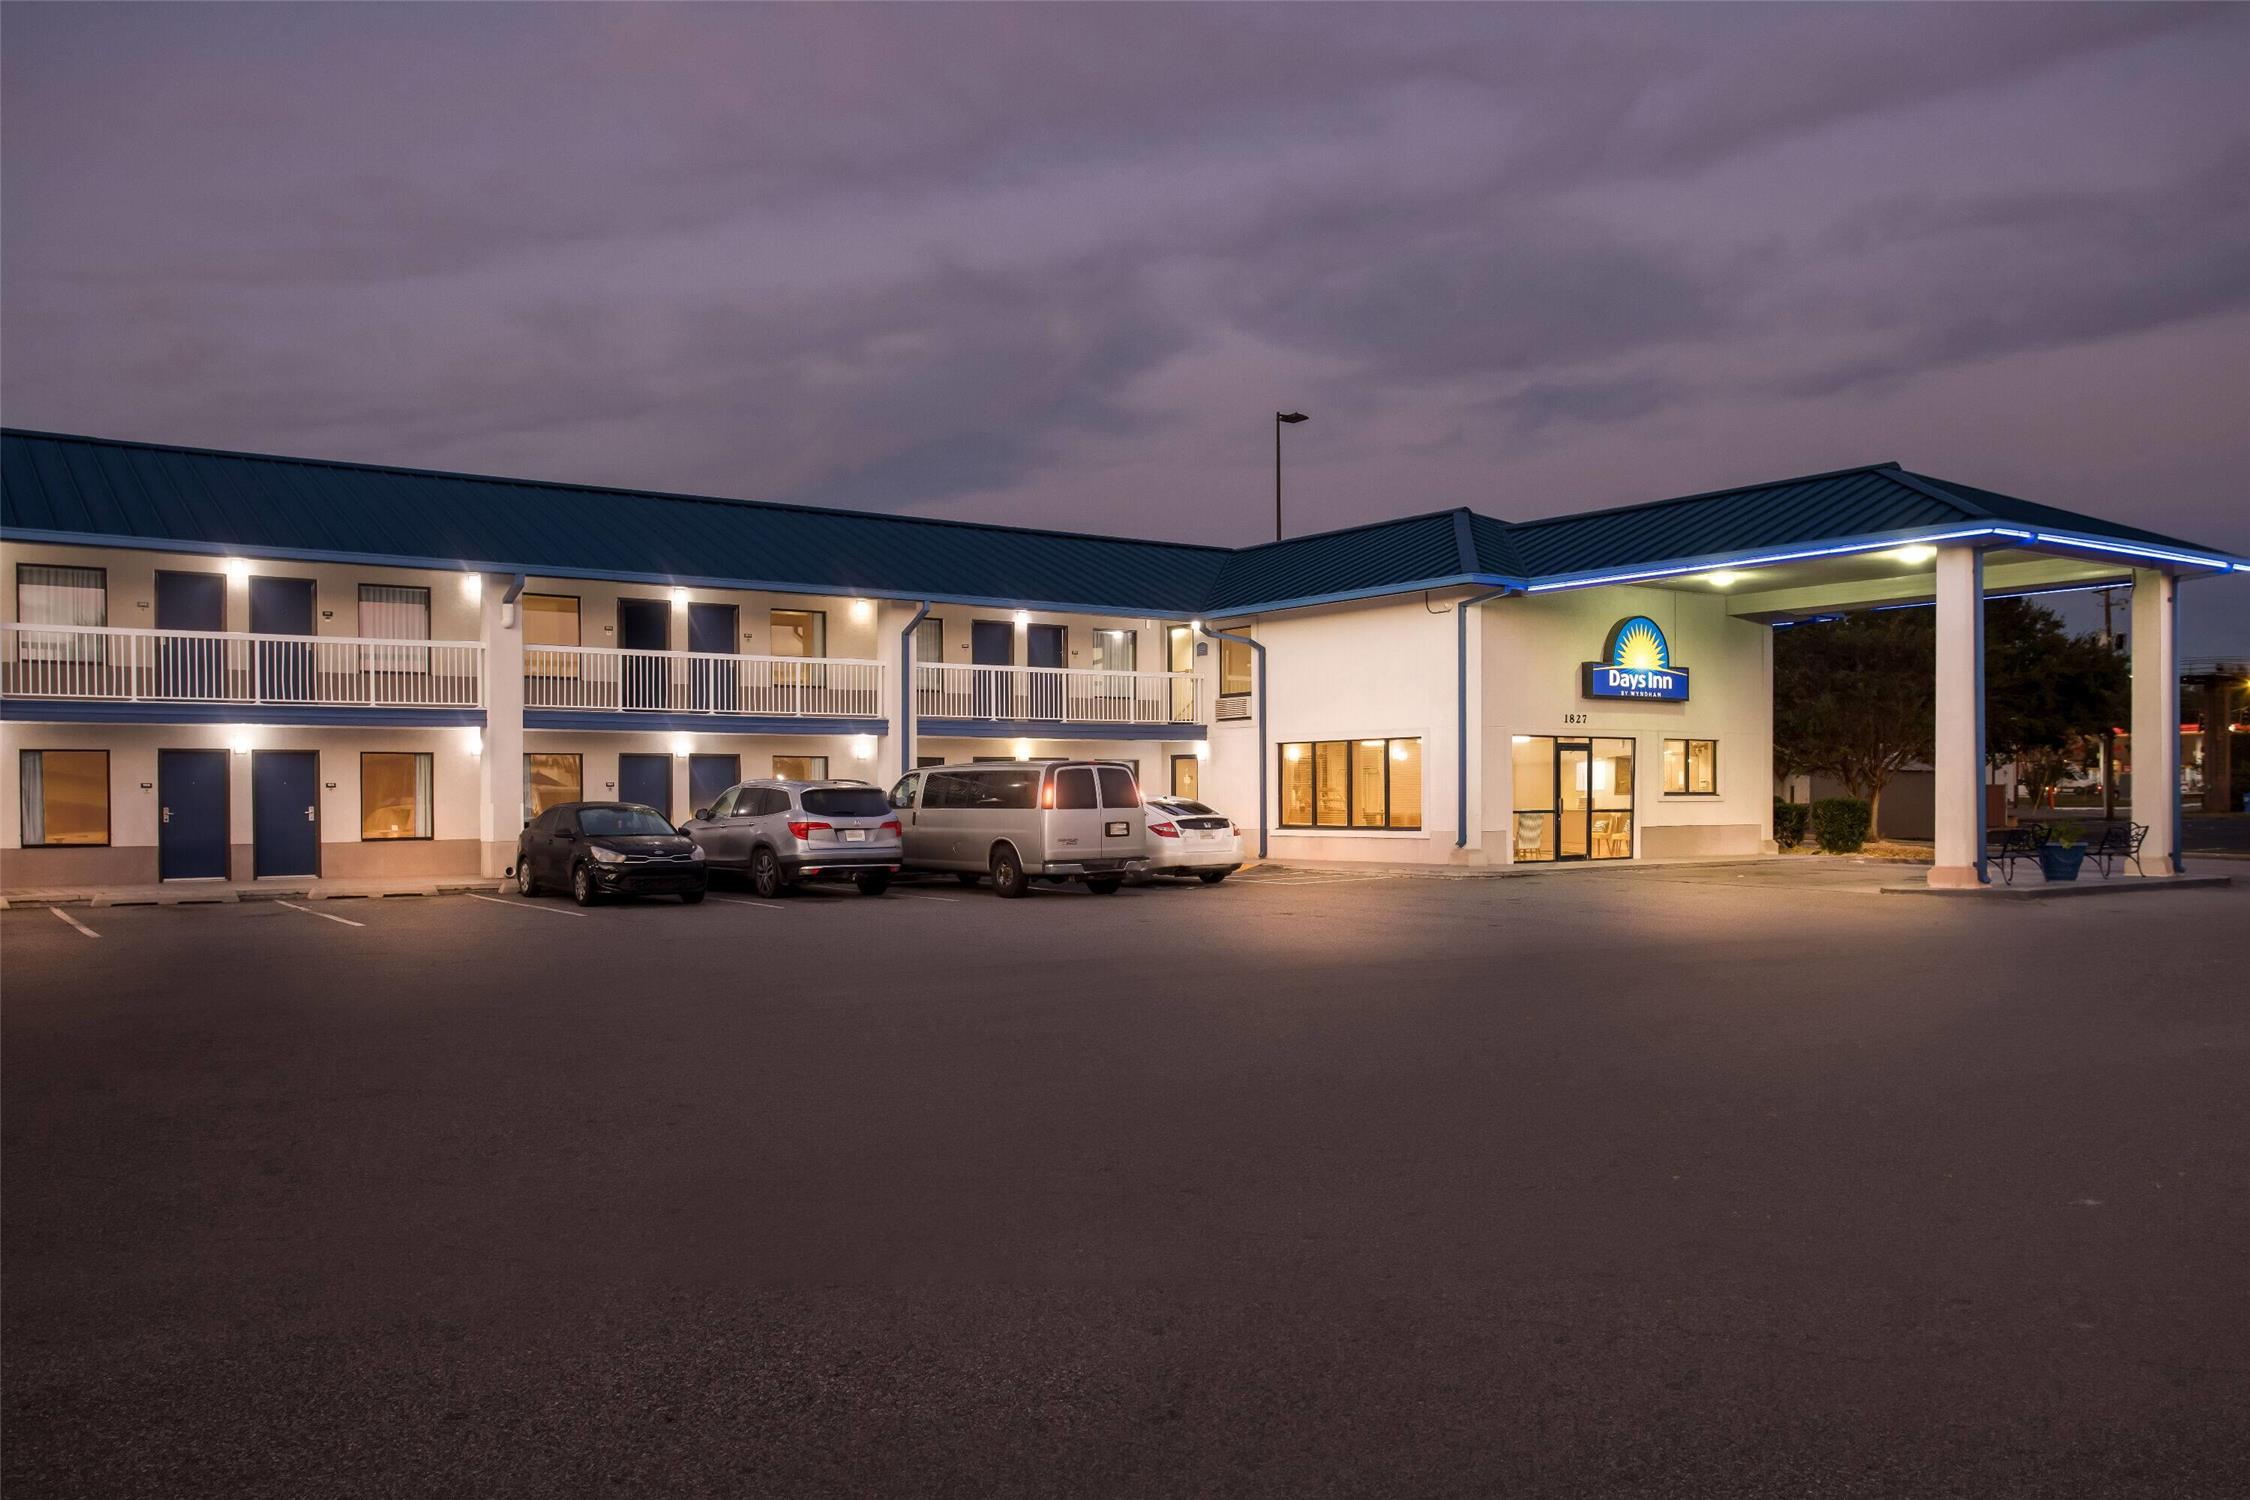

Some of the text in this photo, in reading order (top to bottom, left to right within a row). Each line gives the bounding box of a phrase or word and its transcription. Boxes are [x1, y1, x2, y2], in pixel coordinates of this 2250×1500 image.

[1609, 669, 1672, 690] Days Inn
[1564, 714, 1587, 723] 1827
